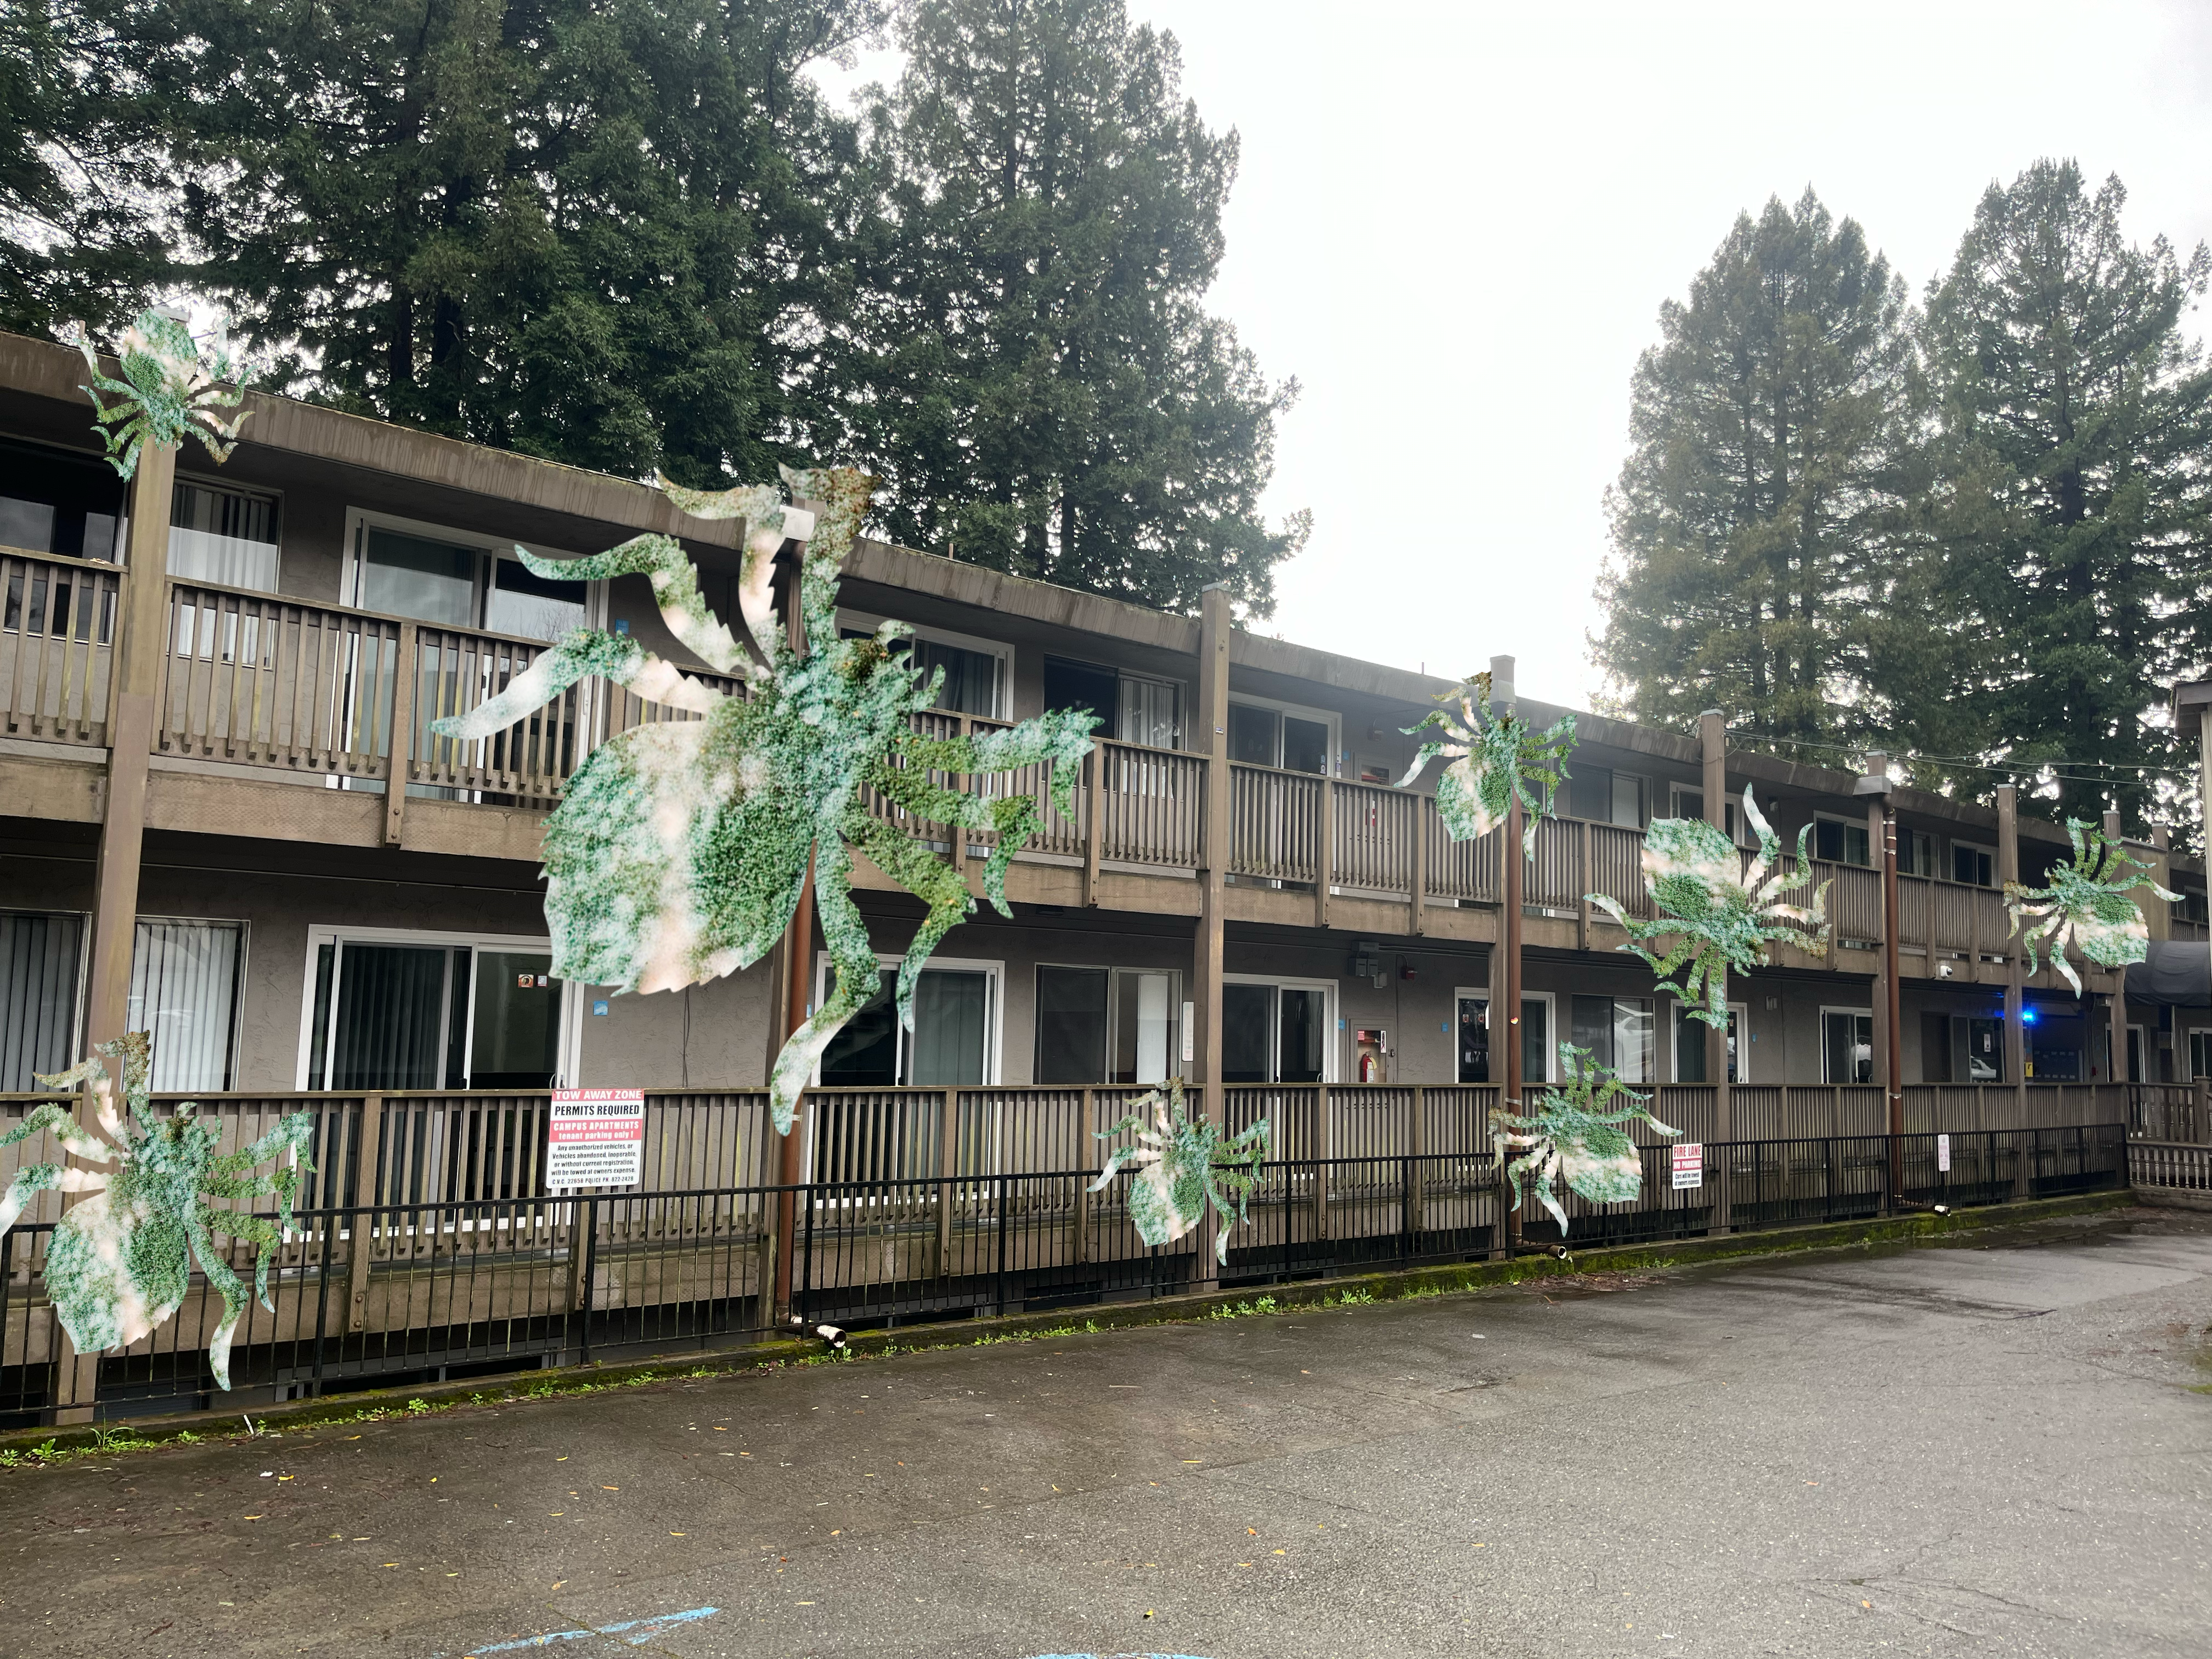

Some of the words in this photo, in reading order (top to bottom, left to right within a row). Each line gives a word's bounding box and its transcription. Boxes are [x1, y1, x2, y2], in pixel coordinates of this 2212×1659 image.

[556, 1090, 580, 1100] TOW
[583, 1090, 613, 1100] AWAY
[614, 1090, 642, 1099] ZONE
[555, 1105, 595, 1116] PERMITS
[597, 1105, 640, 1116] REQUIRED
[554, 1122, 587, 1131] CAMPUS
[589, 1121, 639, 1130] APARTMENTS
[585, 1131, 612, 1140] parking
[614, 1131, 629, 1139] only
[1674, 1146, 1686, 1157] FIRE
[1688, 1145, 1701, 1156] LANE
[1673, 1160, 1681, 1169] NO
[1681, 1159, 1701, 1169] PARKING
